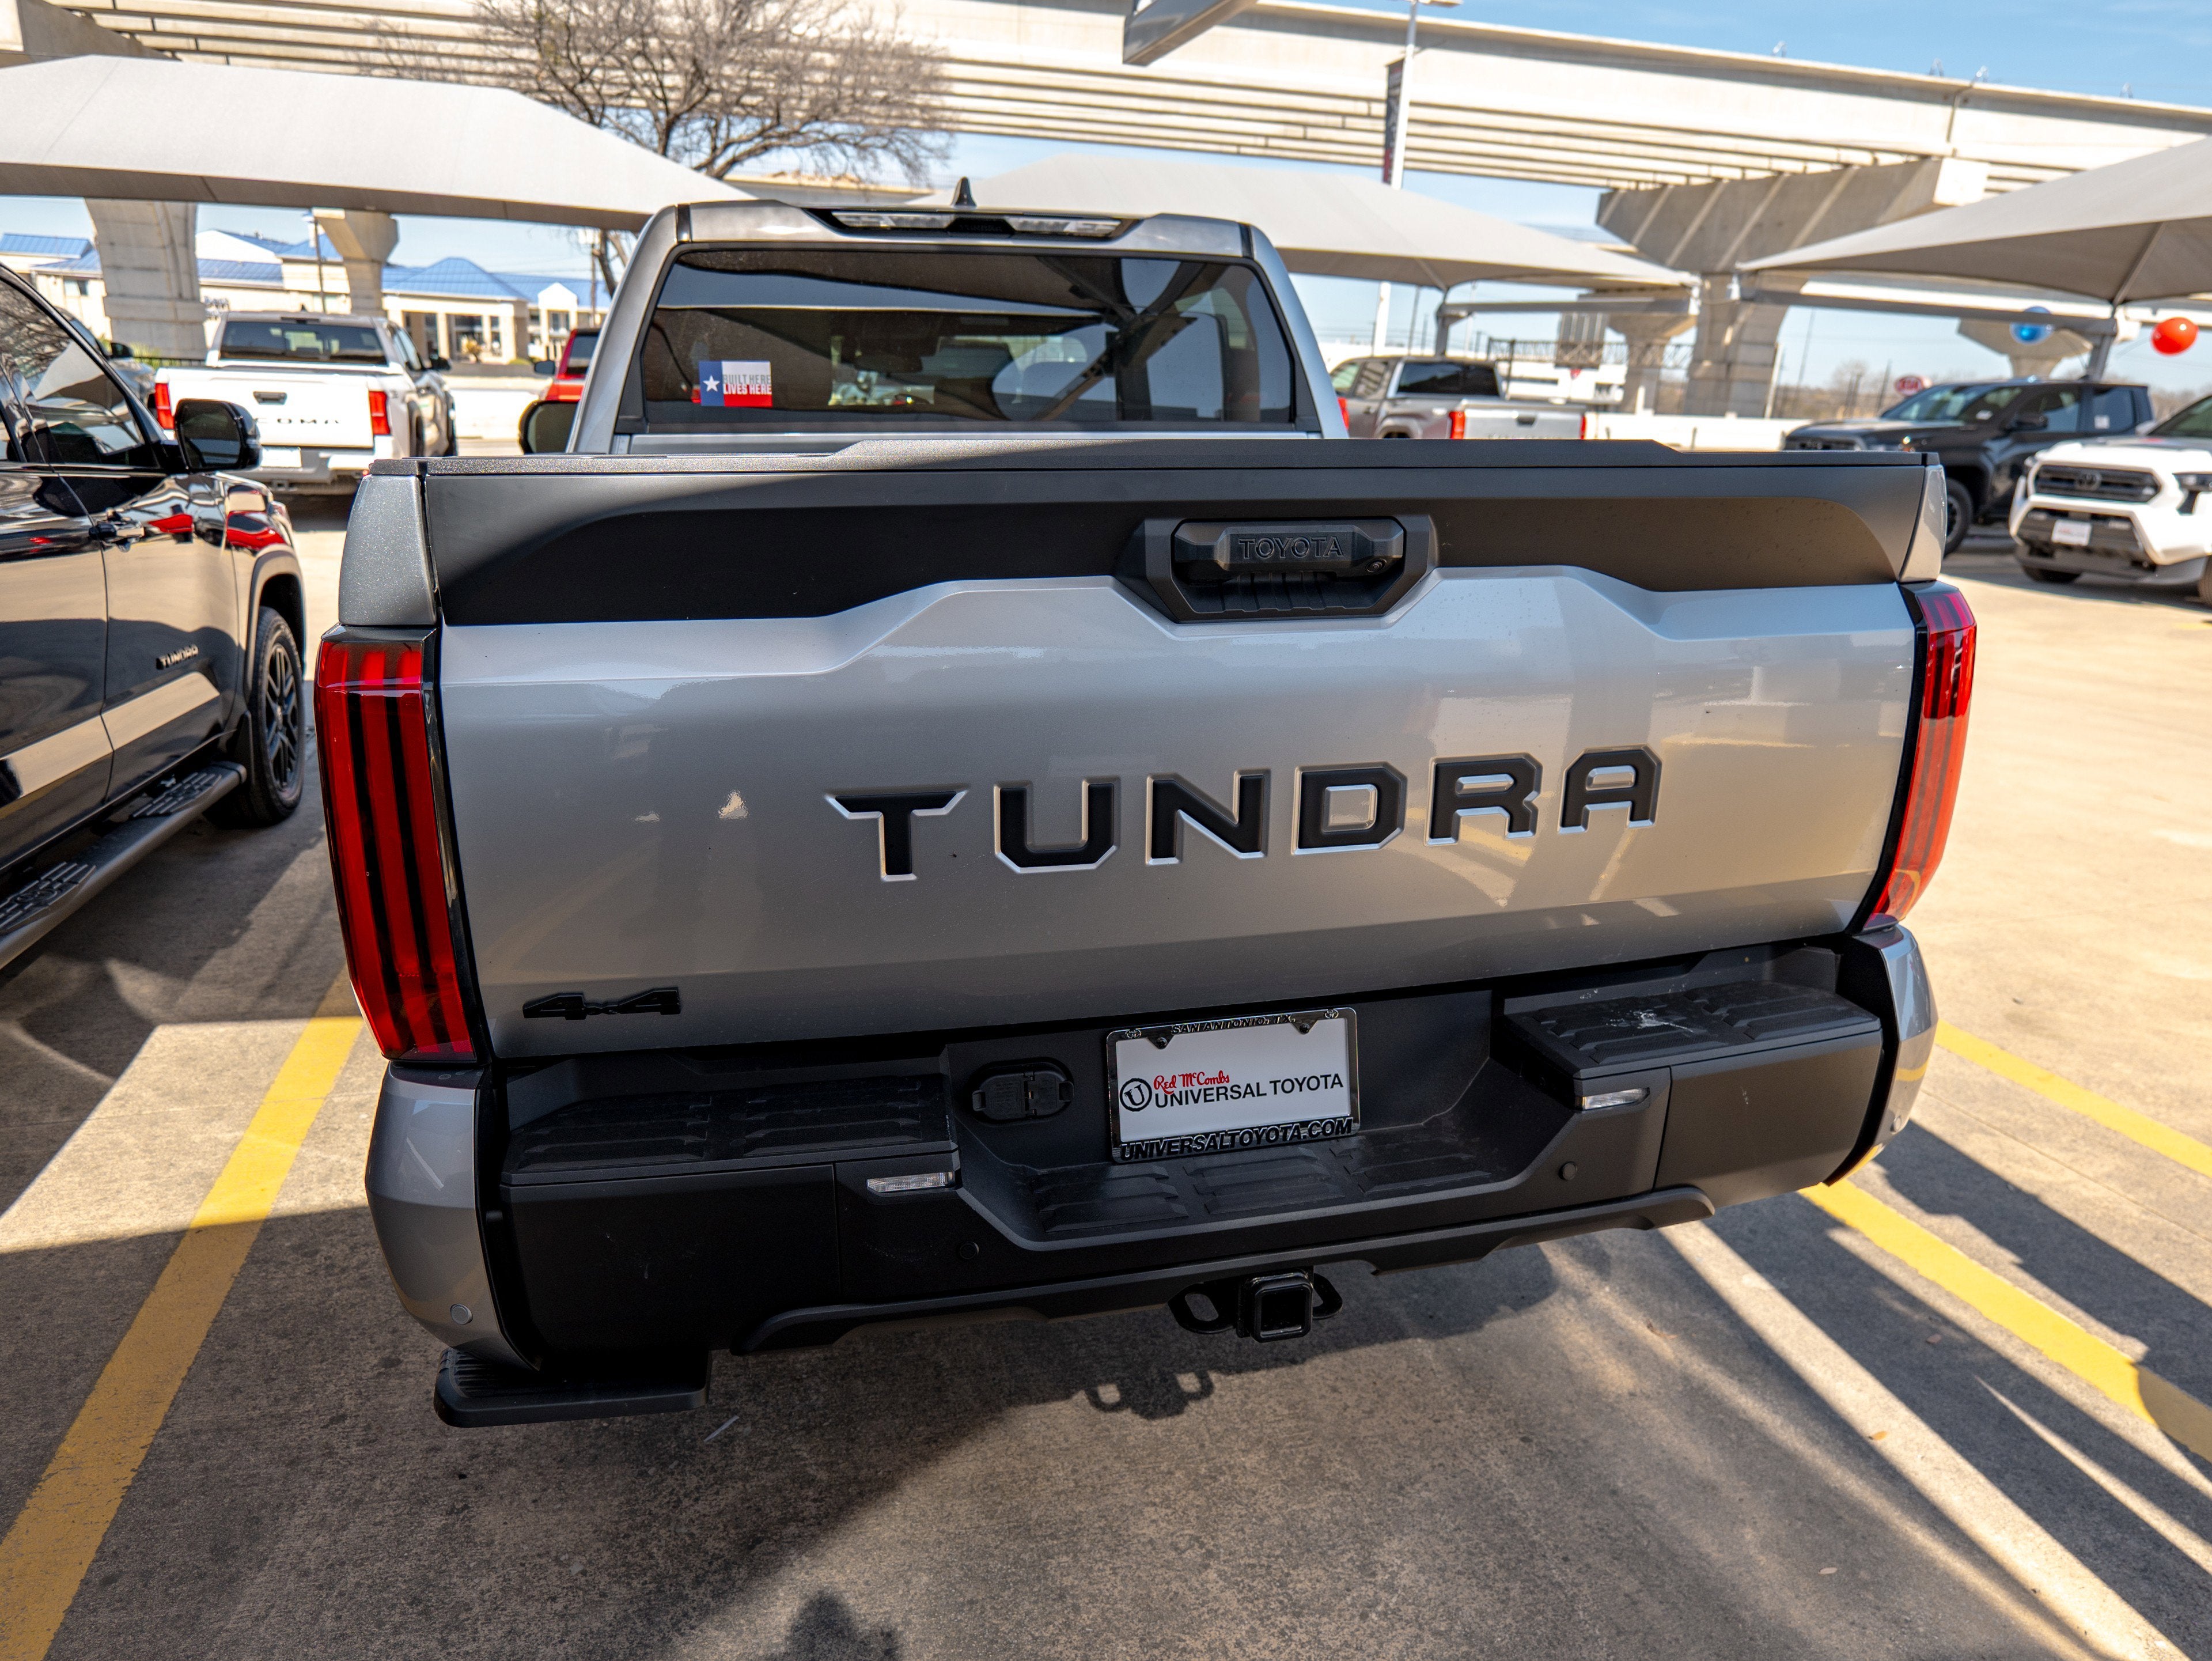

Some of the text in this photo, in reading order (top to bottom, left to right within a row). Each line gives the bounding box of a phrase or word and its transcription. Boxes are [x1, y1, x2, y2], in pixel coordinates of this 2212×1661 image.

[723, 374, 771, 384] BUILT HERE
[724, 384, 772, 395] LIVES HERE
[1238, 535, 1344, 559] TOYOTA
[157, 644, 199, 669] TUNDRA
[825, 744, 1664, 882] TUNDRA
[1171, 1024, 1200, 1035] SAN
[1154, 1070, 1230, 1095] Red McCombs
[1154, 1073, 1344, 1108] UNIVERSAL TOYOTA
[1120, 1117, 1354, 1160] UNIVERSALTOYOTA.COM
